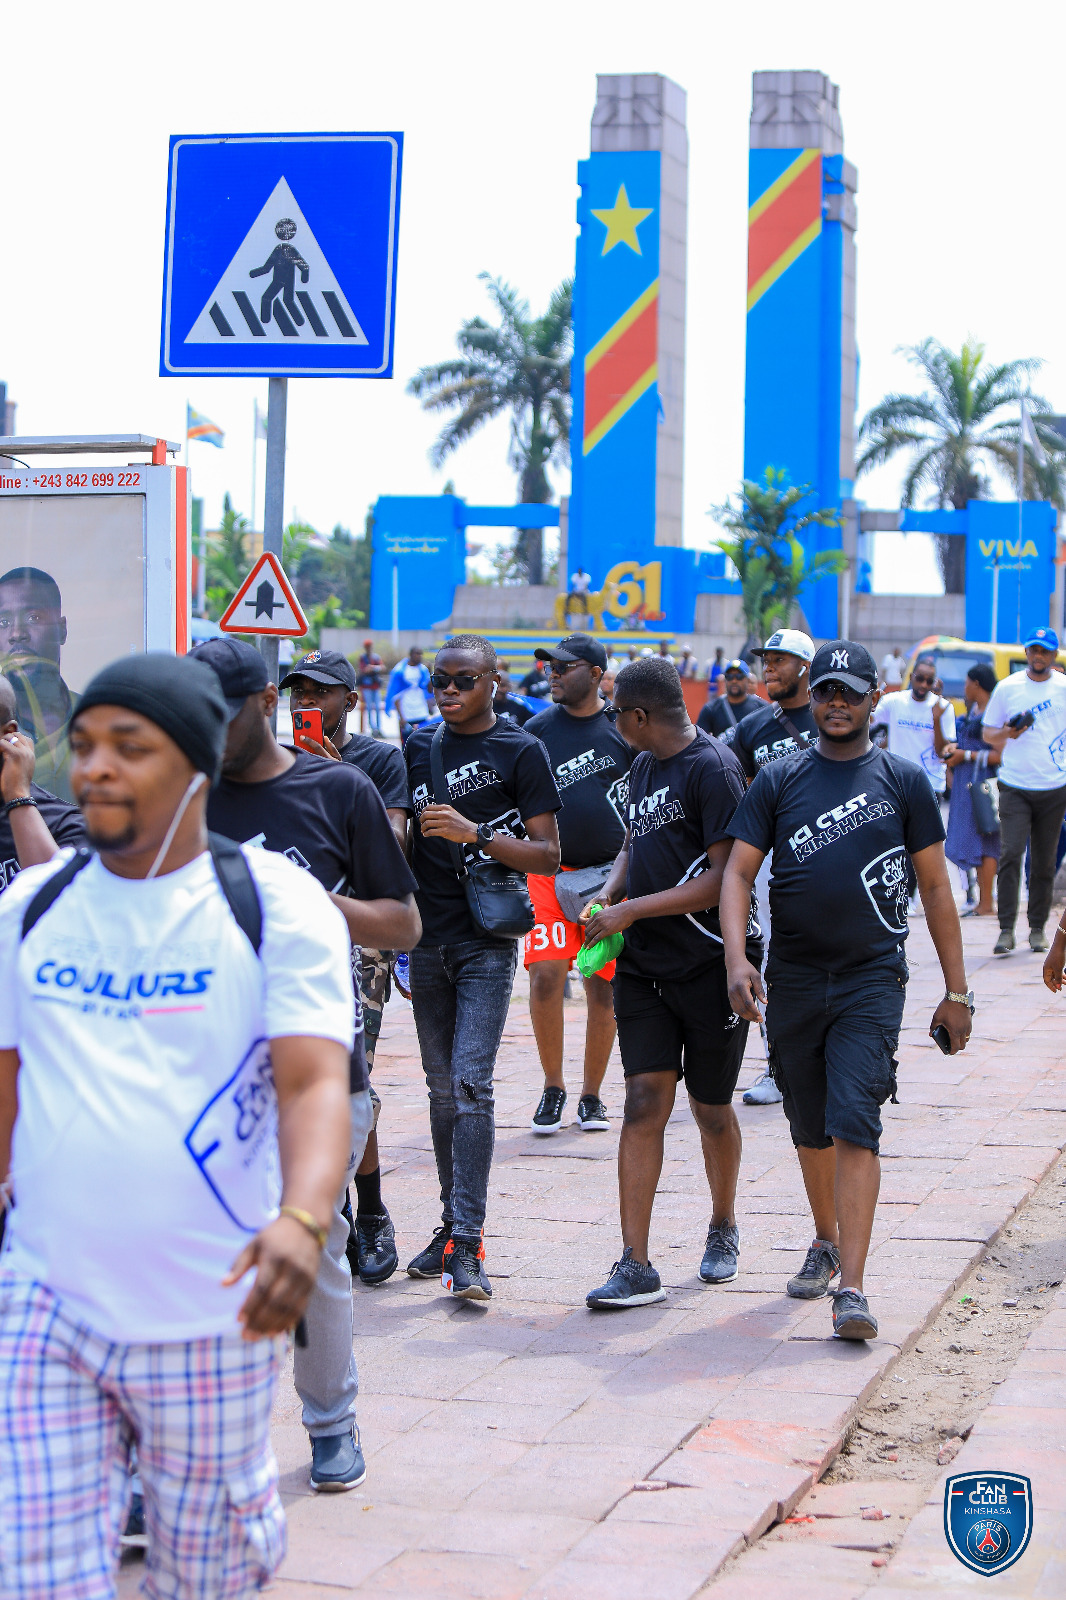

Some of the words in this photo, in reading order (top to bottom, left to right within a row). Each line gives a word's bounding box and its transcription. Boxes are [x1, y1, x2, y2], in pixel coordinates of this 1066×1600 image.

[33, 474, 62, 488] +243
[66, 474, 88, 487] 842
[92, 472, 114, 487] 699
[118, 472, 140, 486] 222
[979, 539, 1039, 557] VIVA
[604, 560, 662, 619] 61
[772, 730, 811, 751] C'ET
[556, 748, 596, 777] C'EST
[788, 824, 814, 852] ICI
[816, 792, 868, 830] C'EST
[795, 800, 895, 863] KINSHASA
[533, 921, 566, 950] 30
